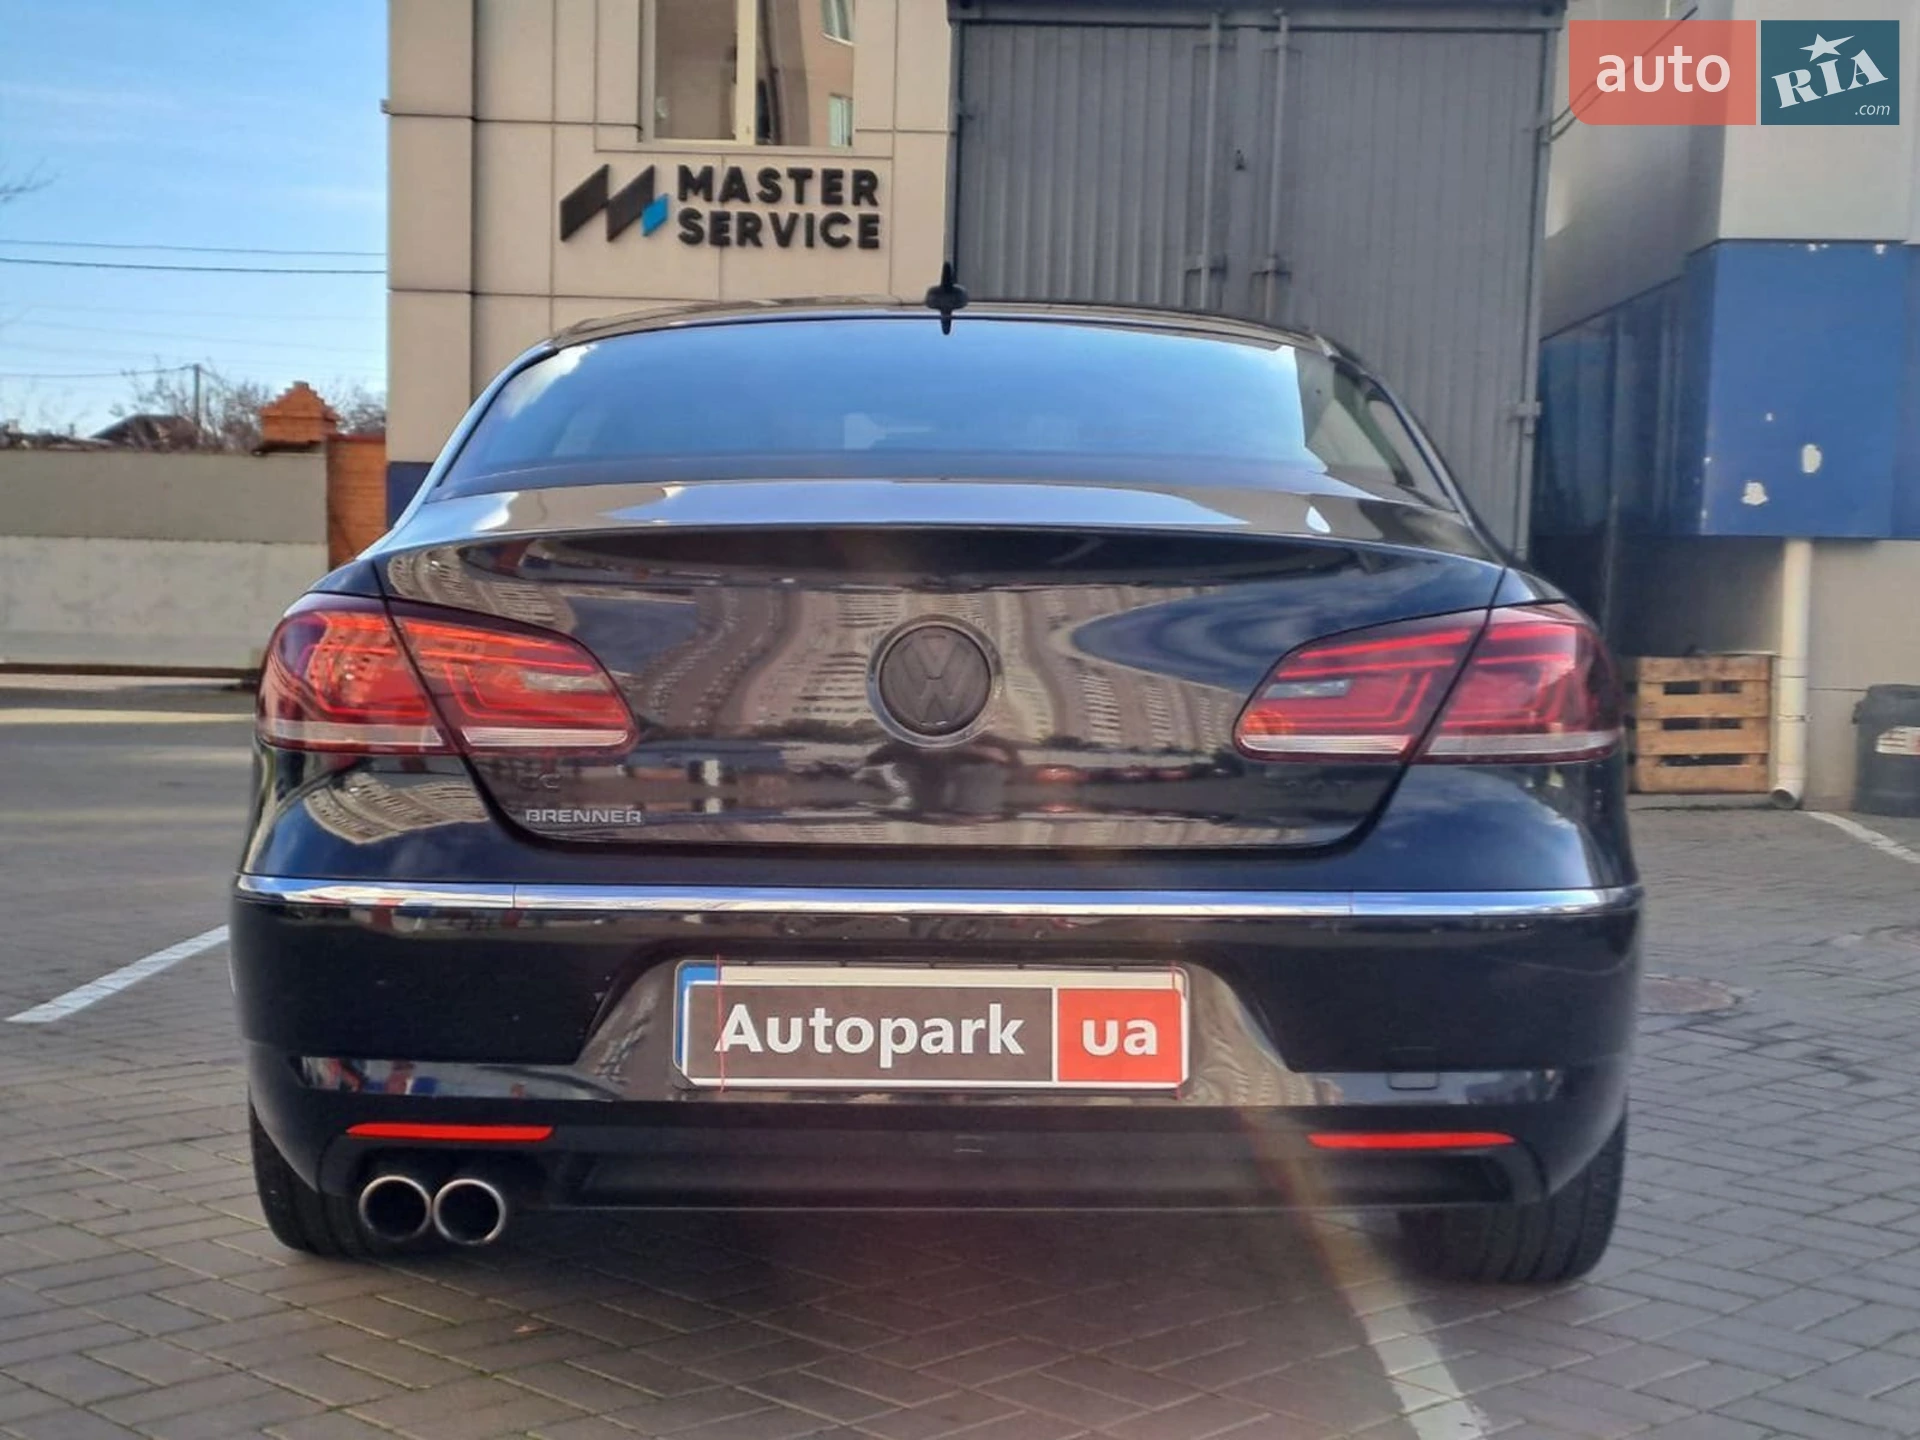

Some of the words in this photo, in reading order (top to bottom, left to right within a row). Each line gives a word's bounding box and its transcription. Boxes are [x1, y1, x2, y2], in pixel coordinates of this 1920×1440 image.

[677, 164, 880, 207] MASTER
[677, 207, 881, 250] SERVICE
[525, 808, 643, 824] BRENNER
[714, 1003, 1025, 1069] Autopark
[1081, 1017, 1159, 1056] ua
